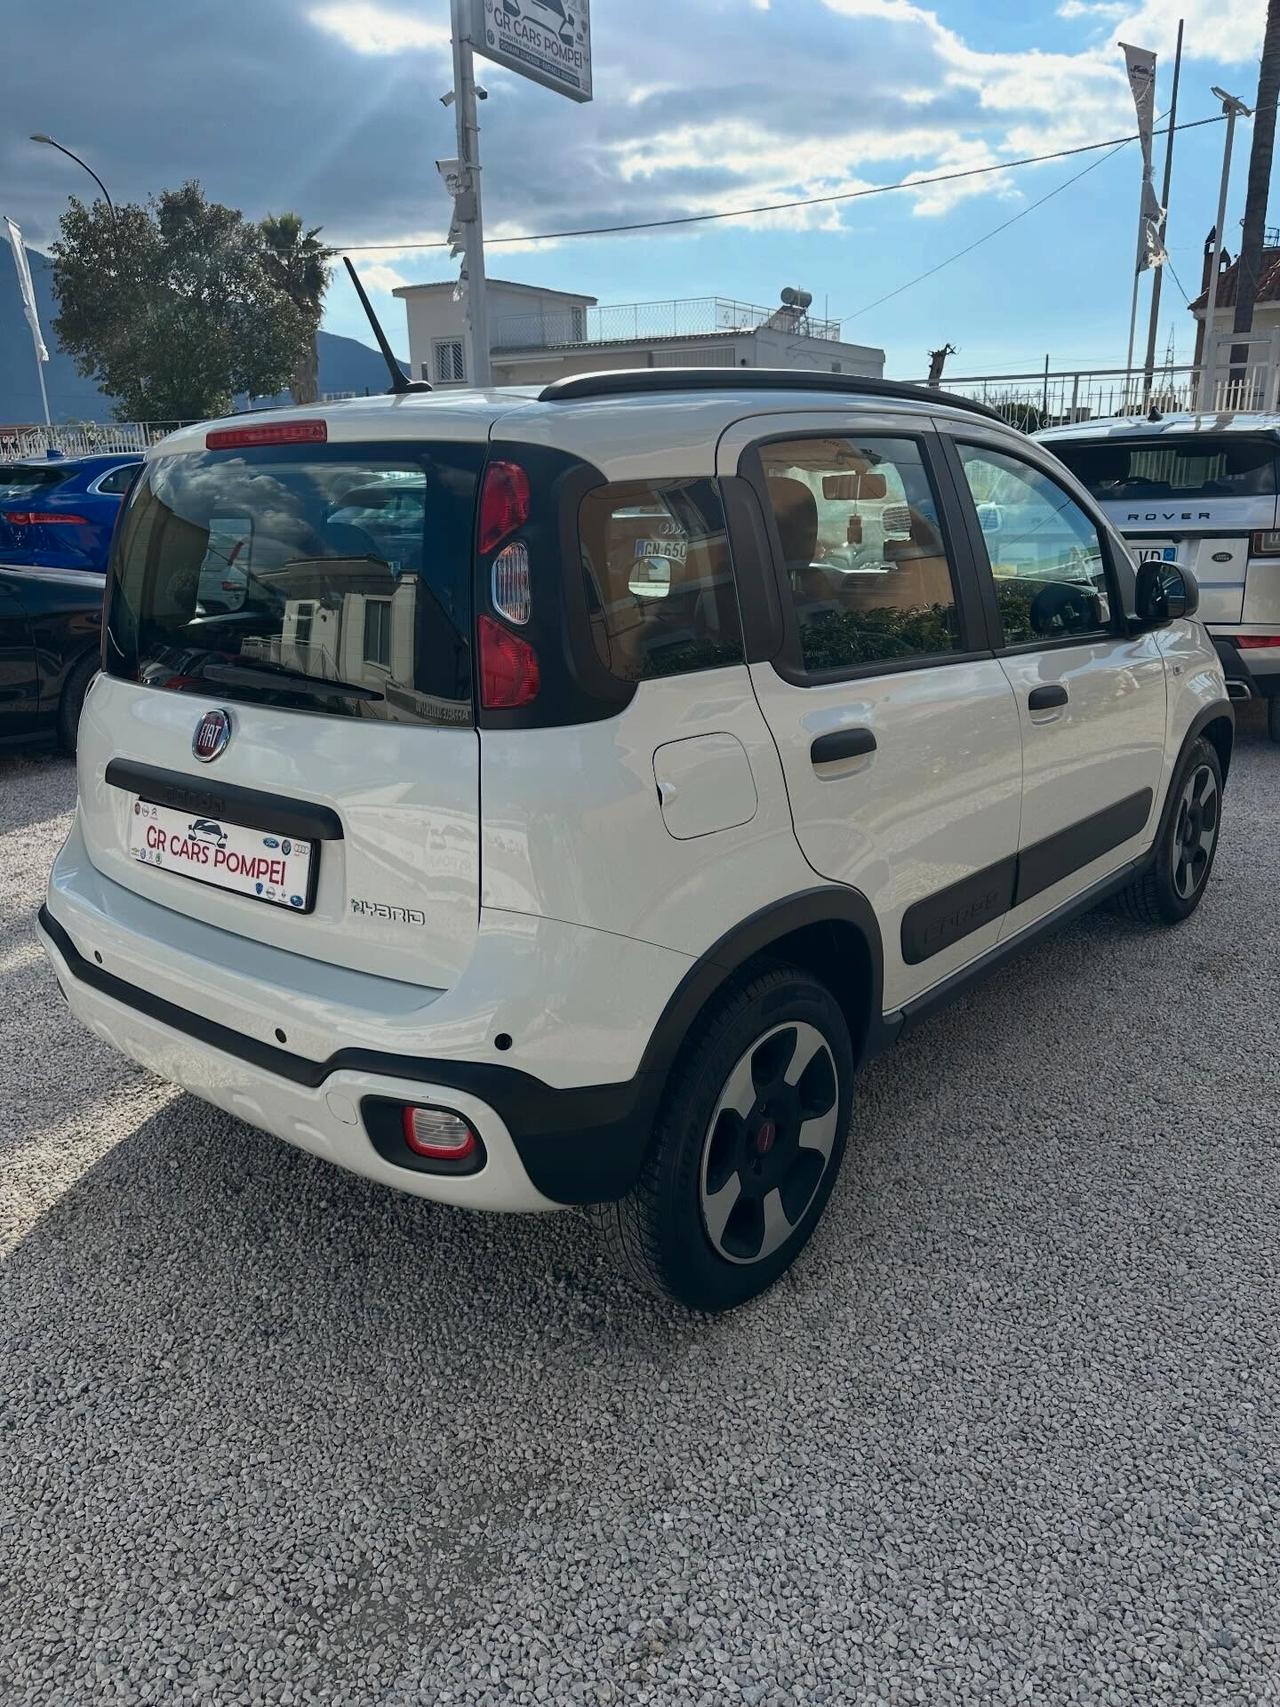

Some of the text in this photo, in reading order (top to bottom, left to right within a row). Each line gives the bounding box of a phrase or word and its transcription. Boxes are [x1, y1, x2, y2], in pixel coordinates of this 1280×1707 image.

[494, 7, 511, 33] GR
[514, 20, 542, 47] CARS
[544, 37, 583, 70] POMPEI
[1127, 512, 1211, 521] ROVER
[198, 723, 222, 748] FIAT
[146, 825, 286, 886] GR CARS POMPEI
